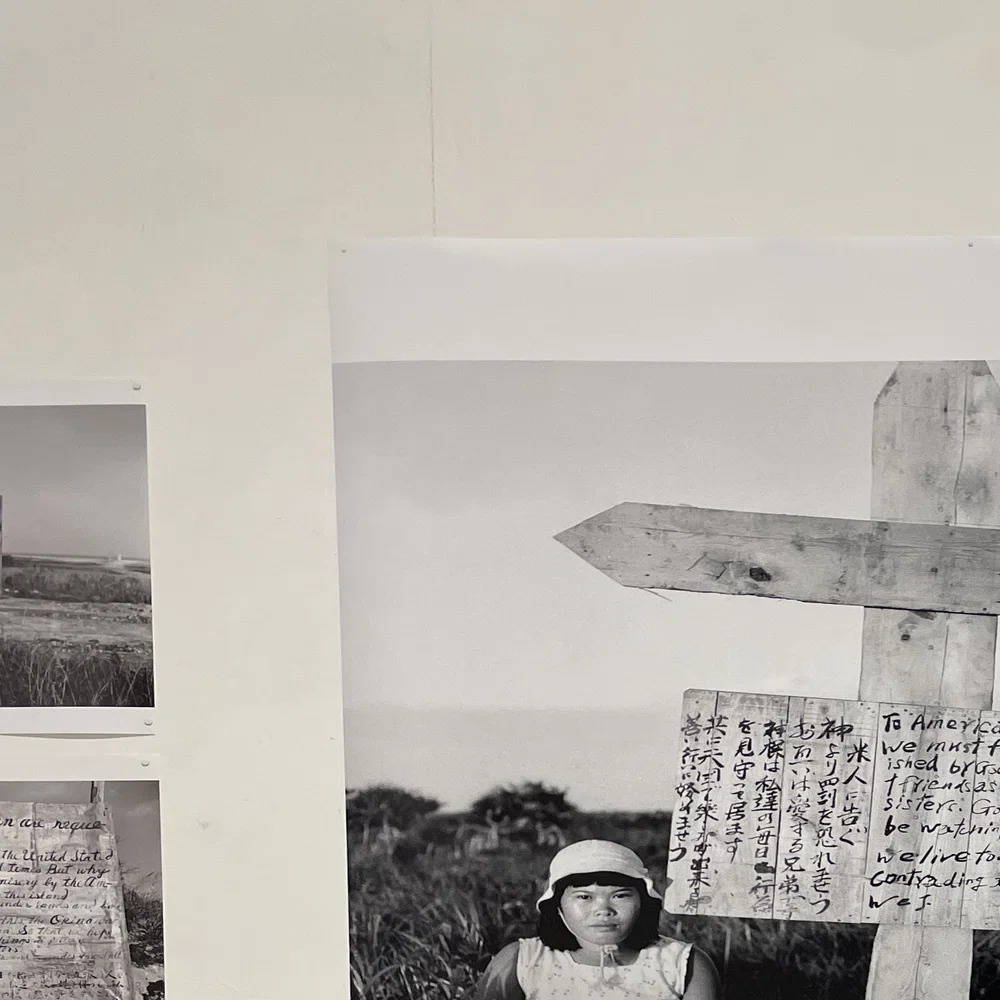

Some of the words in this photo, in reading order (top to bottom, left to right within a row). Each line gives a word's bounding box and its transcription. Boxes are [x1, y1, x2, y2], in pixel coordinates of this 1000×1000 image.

[926, 738, 985, 754] must
[887, 754, 938, 772] ished
[837, 738, 871, 846] 米人に告ぐ
[884, 815, 910, 836] be
